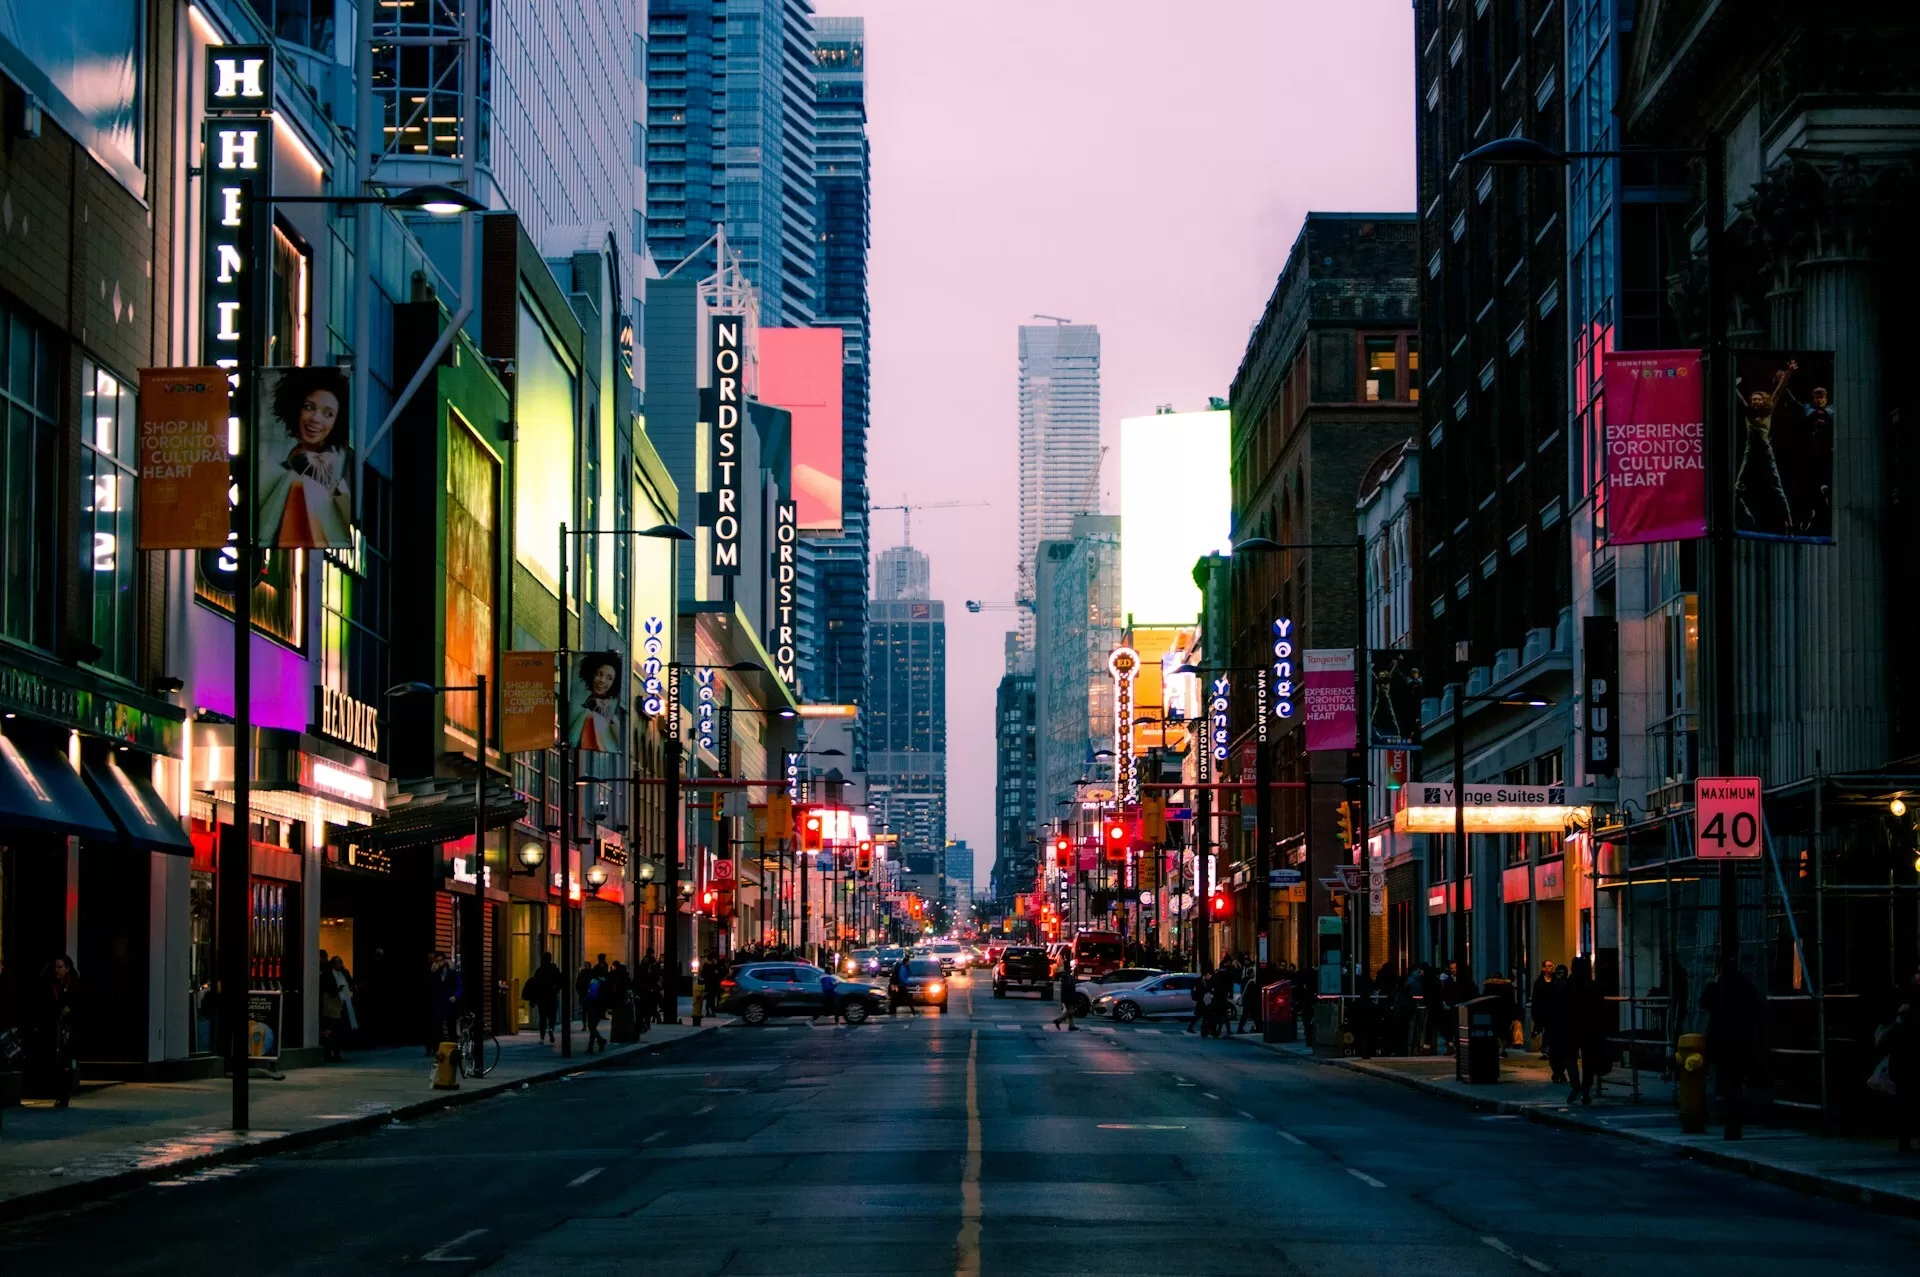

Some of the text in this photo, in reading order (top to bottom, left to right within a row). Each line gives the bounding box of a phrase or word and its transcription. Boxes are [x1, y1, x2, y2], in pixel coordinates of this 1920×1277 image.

[144, 420, 208, 435] SHOP IN
[1606, 423, 1704, 440] EXPERIENCE
[140, 434, 228, 449] TORONTO'S
[716, 323, 738, 566] NORDSTROM
[1607, 440, 1703, 455] TORONTO'S
[151, 449, 229, 464] CULTURAL
[1619, 456, 1704, 471] CULTURAL
[143, 465, 195, 479] HEART
[1610, 472, 1667, 487] HEART
[777, 505, 794, 683] NORDSTROM
[643, 617, 662, 716] Yonge
[1117, 658, 1131, 667] ED
[1307, 655, 1347, 664] Tangerine
[1273, 618, 1292, 718] Yonge
[505, 681, 543, 689] SHOP IN
[1304, 687, 1356, 696] EXPERIENCE
[509, 697, 556, 706] CULTURAL
[669, 667, 678, 738] DOWNTOWN
[1258, 669, 1266, 742] DOWNTOWN
[1304, 695, 1355, 704] TORONTO'S
[505, 706, 535, 714] HEART
[699, 668, 714, 748] Yonge
[1311, 704, 1356, 712] CULTURAL
[322, 685, 379, 753] HENDRIKS
[1213, 679, 1229, 760] Yonge
[1306, 712, 1336, 720] HEART
[1591, 678, 1608, 761] PUB
[1120, 678, 1128, 781] MIRVISH
[1444, 790, 1545, 805] Ynge Suites
[1701, 787, 1756, 800] MAXIMUM
[1701, 811, 1757, 848] 40
